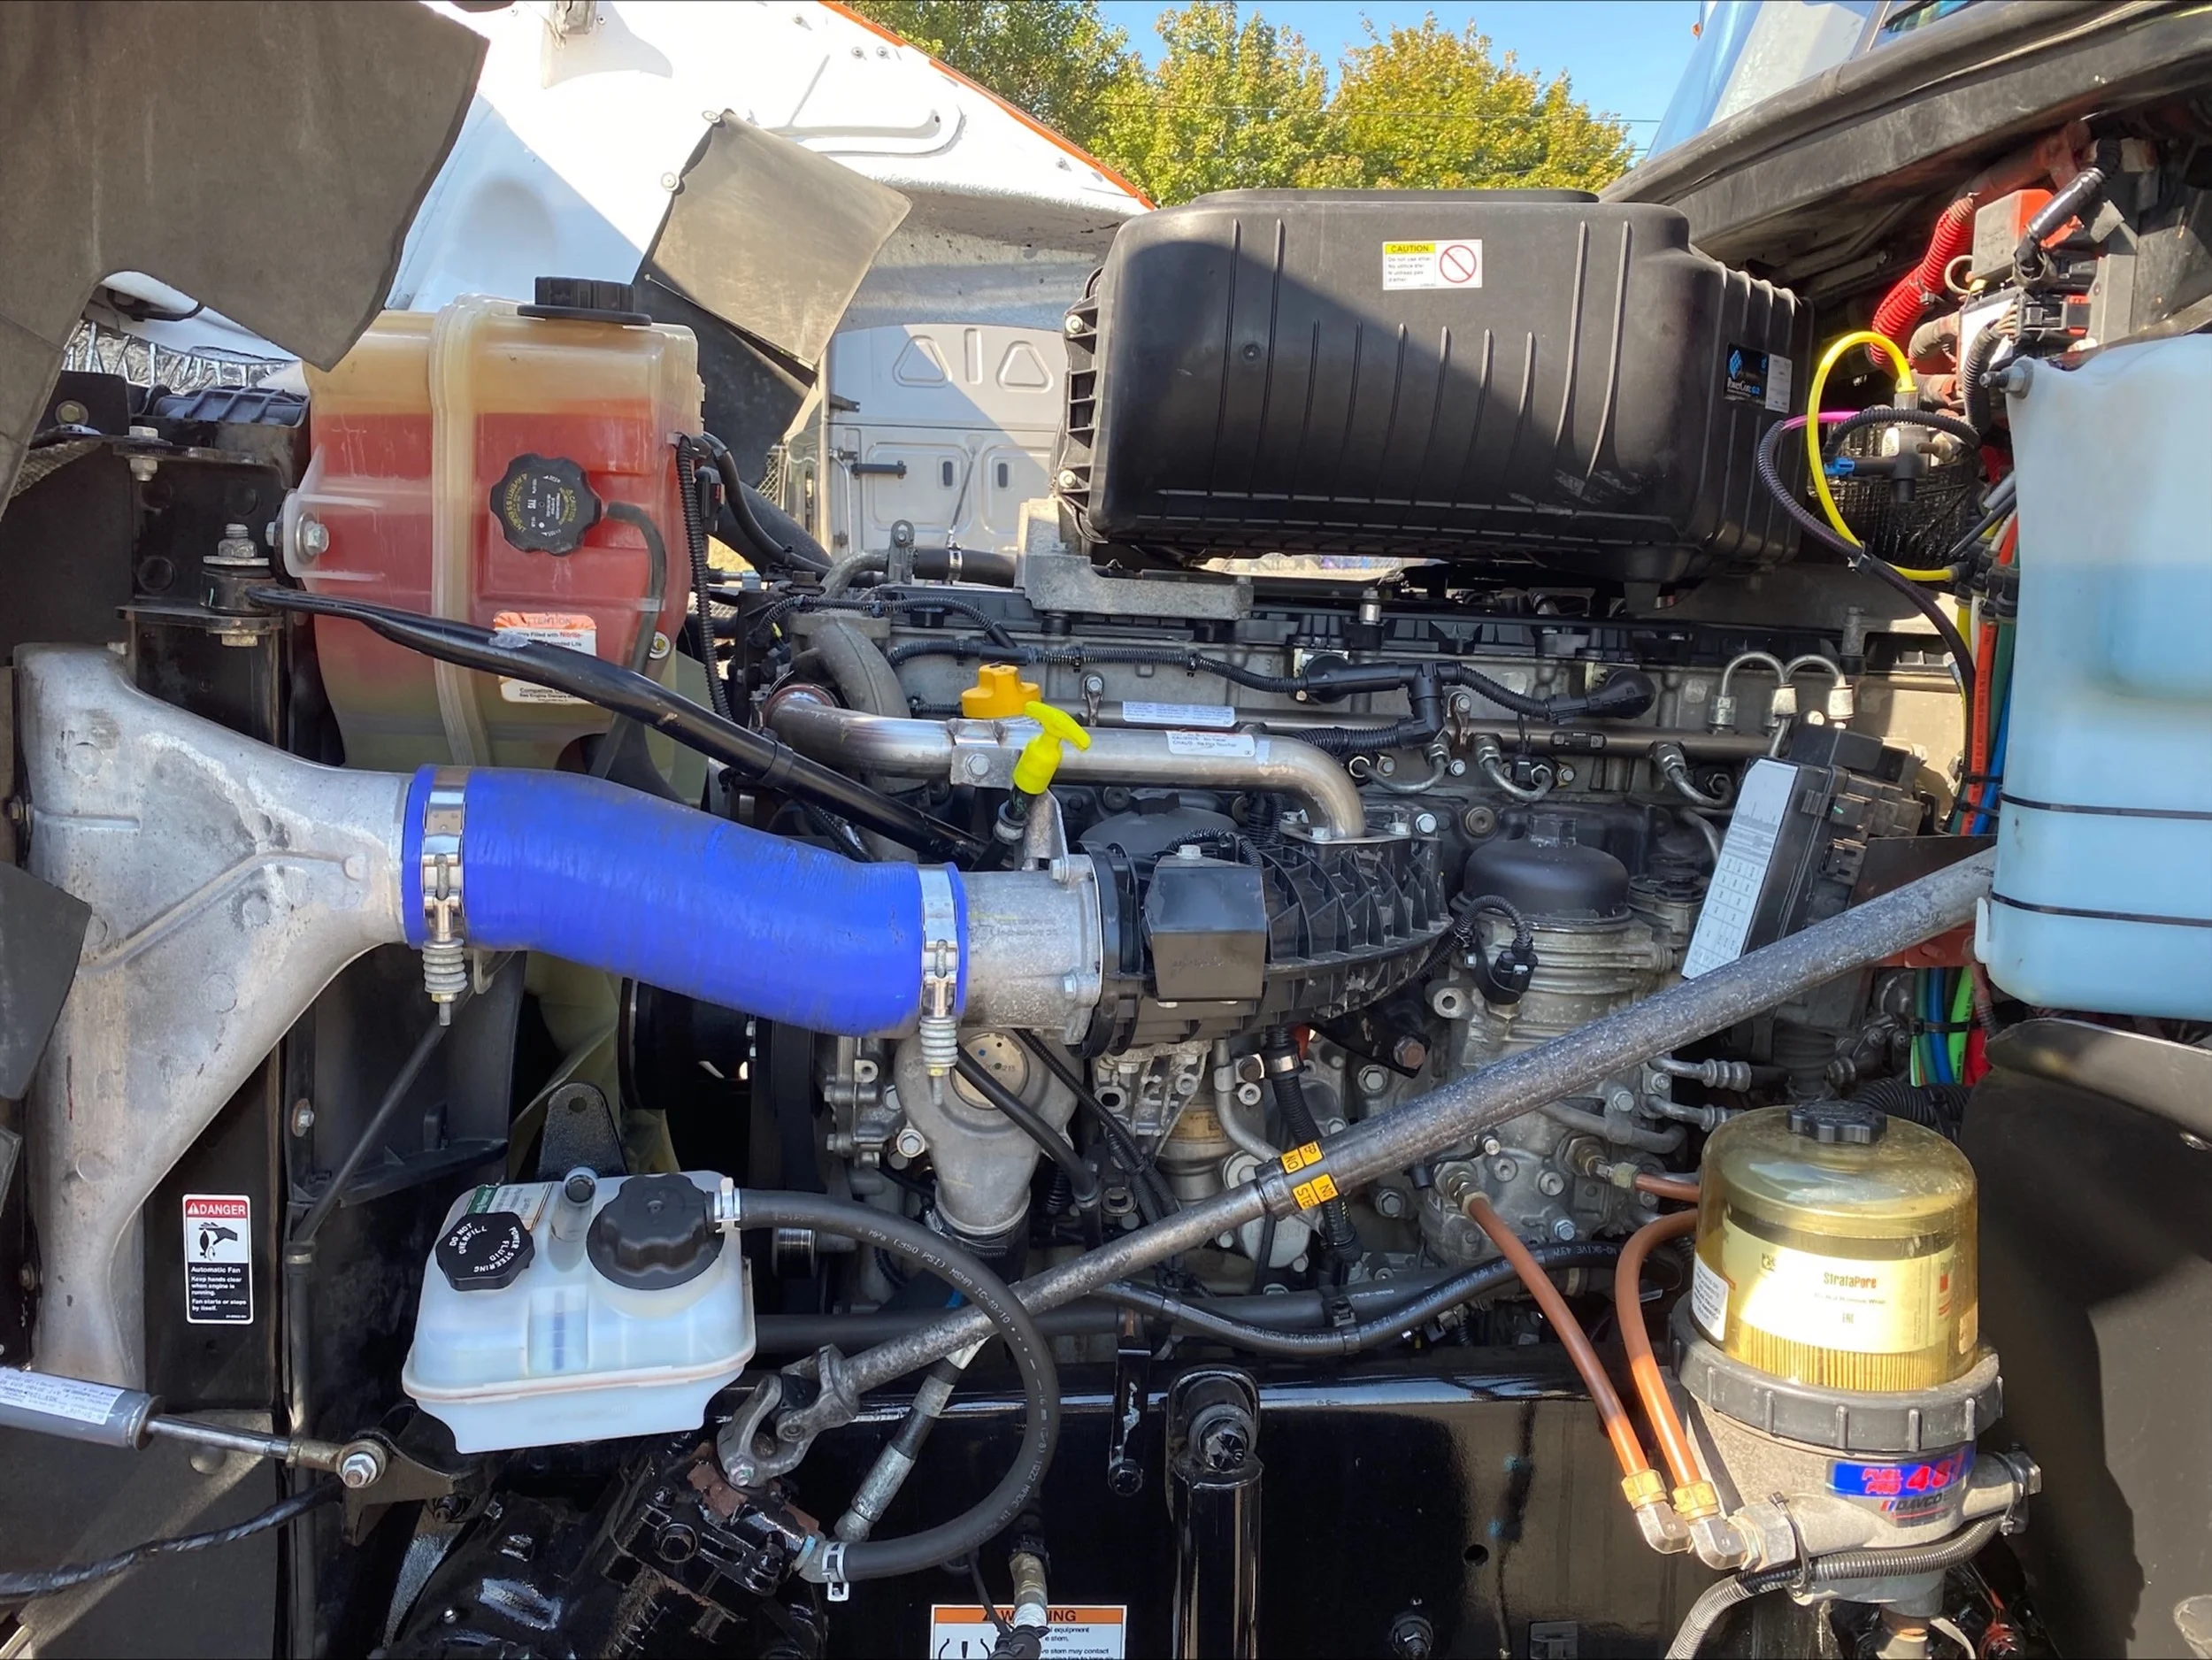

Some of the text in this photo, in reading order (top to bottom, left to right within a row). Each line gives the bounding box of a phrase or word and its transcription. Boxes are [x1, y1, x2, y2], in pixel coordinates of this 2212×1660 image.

[1390, 244, 1430, 253] CAUTION
[199, 1203, 246, 1215] DANGER
[449, 1222, 472, 1247] DO NOT
[458, 1225, 488, 1255] OVERFILL
[508, 1226, 520, 1249] POWER
[473, 1251, 514, 1272] STEERING
[488, 1240, 510, 1262] FLUID
[892, 1238, 920, 1255] (350
[921, 1250, 947, 1269] PSI)
[1823, 1272, 1878, 1289] StrataPore
[1894, 1493, 1943, 1512] DAVCO
[1001, 1610, 1077, 1622] WING
